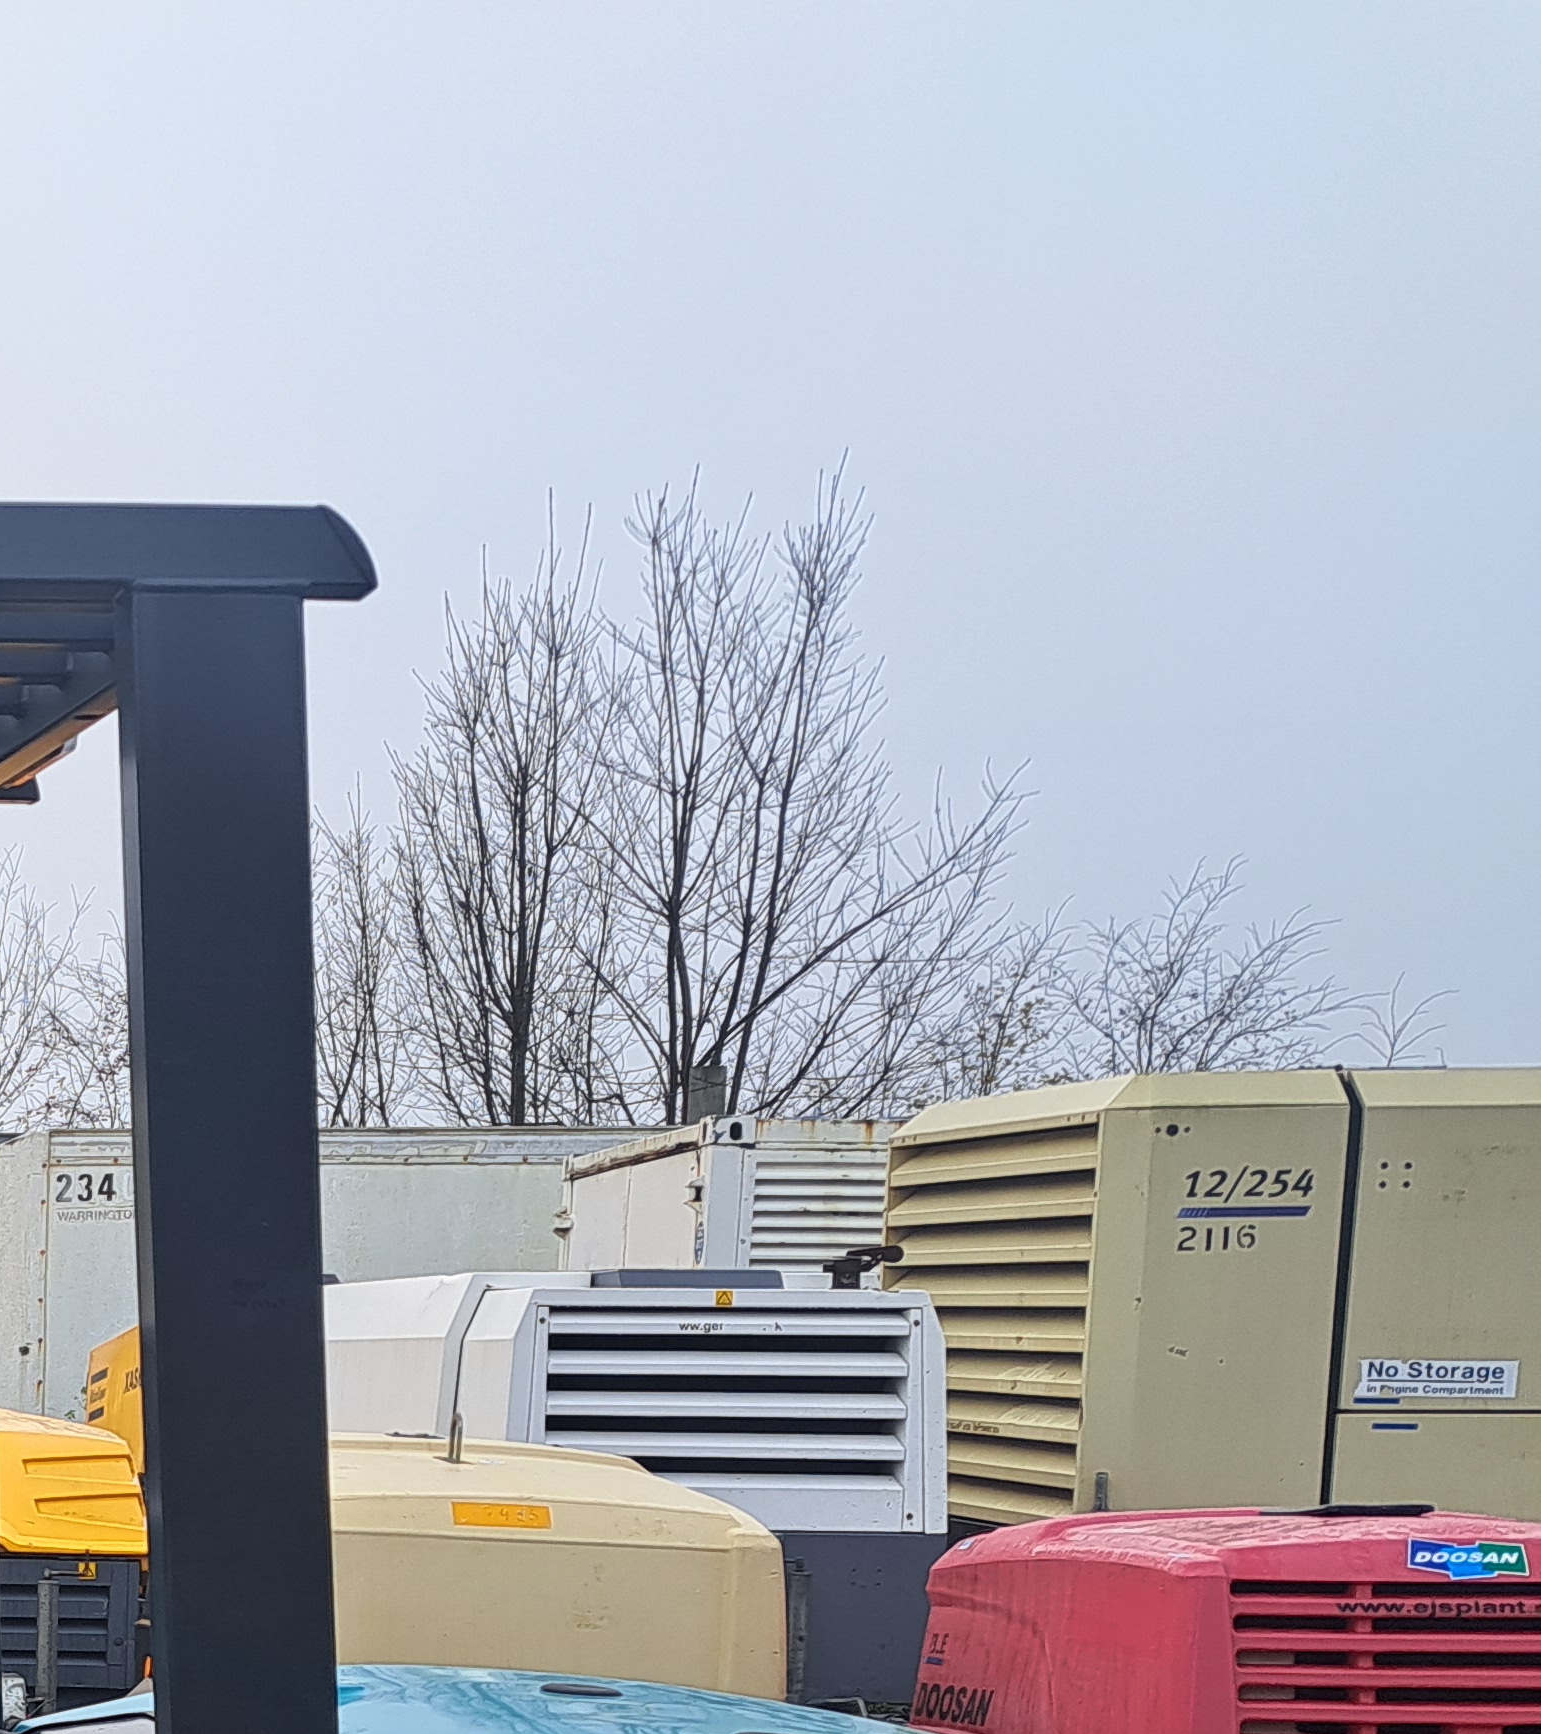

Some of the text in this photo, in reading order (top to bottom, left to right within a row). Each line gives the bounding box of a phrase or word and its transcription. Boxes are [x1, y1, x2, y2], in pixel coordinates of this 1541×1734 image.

[1185, 1165, 1315, 1204] 12/254
[57, 1209, 134, 1221] WARRINGTO
[1176, 1224, 1257, 1251] 2116
[1367, 1361, 1505, 1384] No Storage
[1423, 1384, 1505, 1396] Compartment
[1414, 1551, 1520, 1564] DOOSAN
[914, 1681, 995, 1728] DOOSAN
